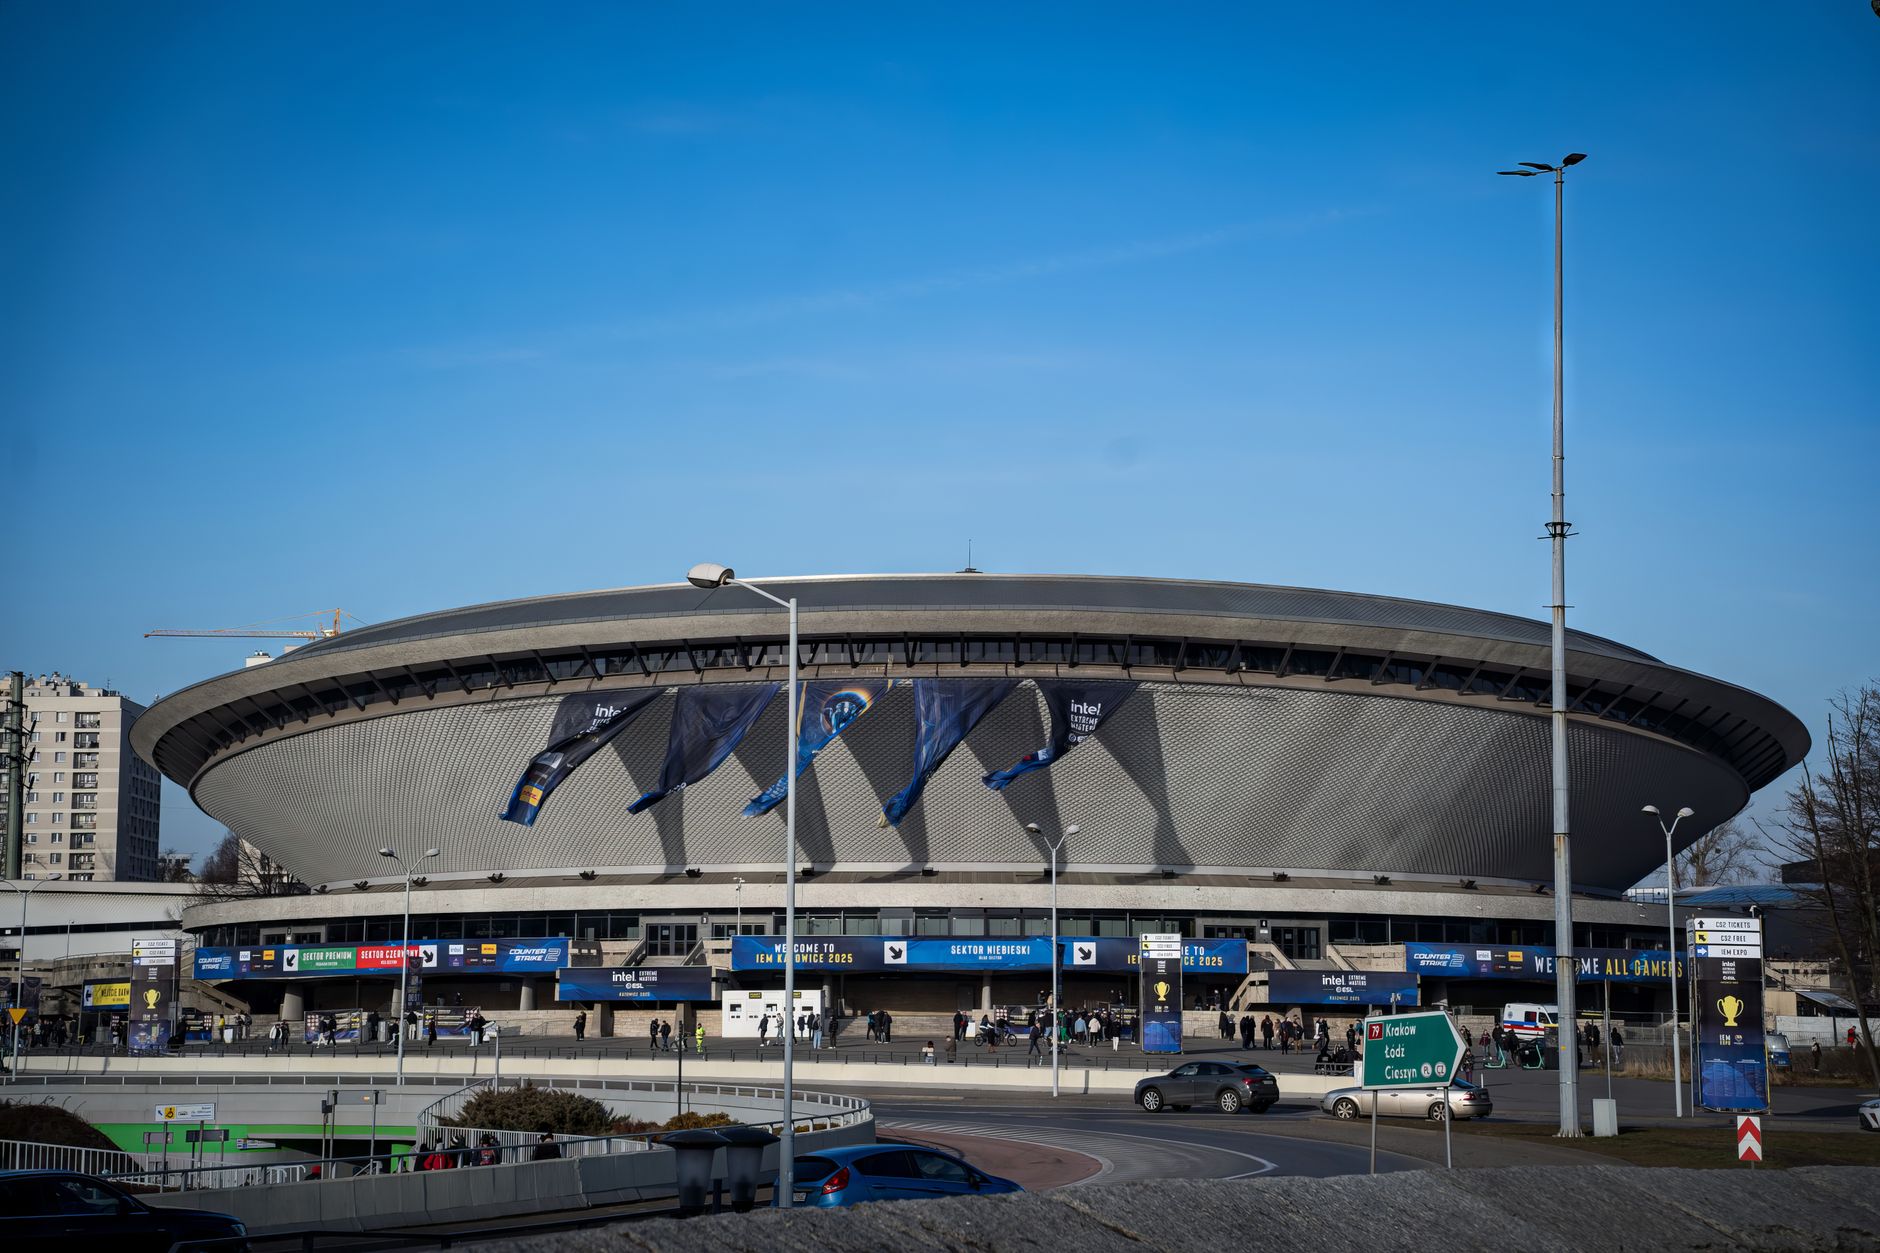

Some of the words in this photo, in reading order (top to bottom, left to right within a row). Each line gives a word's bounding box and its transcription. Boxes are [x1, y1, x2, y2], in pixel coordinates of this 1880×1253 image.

[595, 703, 627, 717] inte
[1070, 699, 1102, 716] intel
[361, 950, 384, 959] SEKTOR
[385, 949, 419, 959] CZERNY
[544, 947, 561, 961] 2
[774, 943, 819, 953] WECOME
[823, 943, 835, 953] TO
[951, 945, 984, 955] SEKTOR
[987, 945, 1030, 955] NIEBIESKI
[1194, 946, 1205, 955] TO
[302, 952, 324, 961] SEKTOR
[325, 951, 352, 961] PREMIUM
[756, 953, 773, 963] IEM
[777, 953, 824, 963] KAOWICE
[828, 953, 853, 963] 2025
[1199, 957, 1223, 966] 2025
[1449, 953, 1465, 967] 2
[1535, 956, 1599, 974] WEME
[1605, 958, 1629, 975] ALL
[612, 971, 636, 982] intel
[1322, 974, 1346, 986] intel
[1372, 1025, 1380, 1038] 79
[1386, 1022, 1417, 1037] Kraków
[1385, 1044, 1405, 1059] Łódź
[1385, 1066, 1417, 1083] Cieszyn
